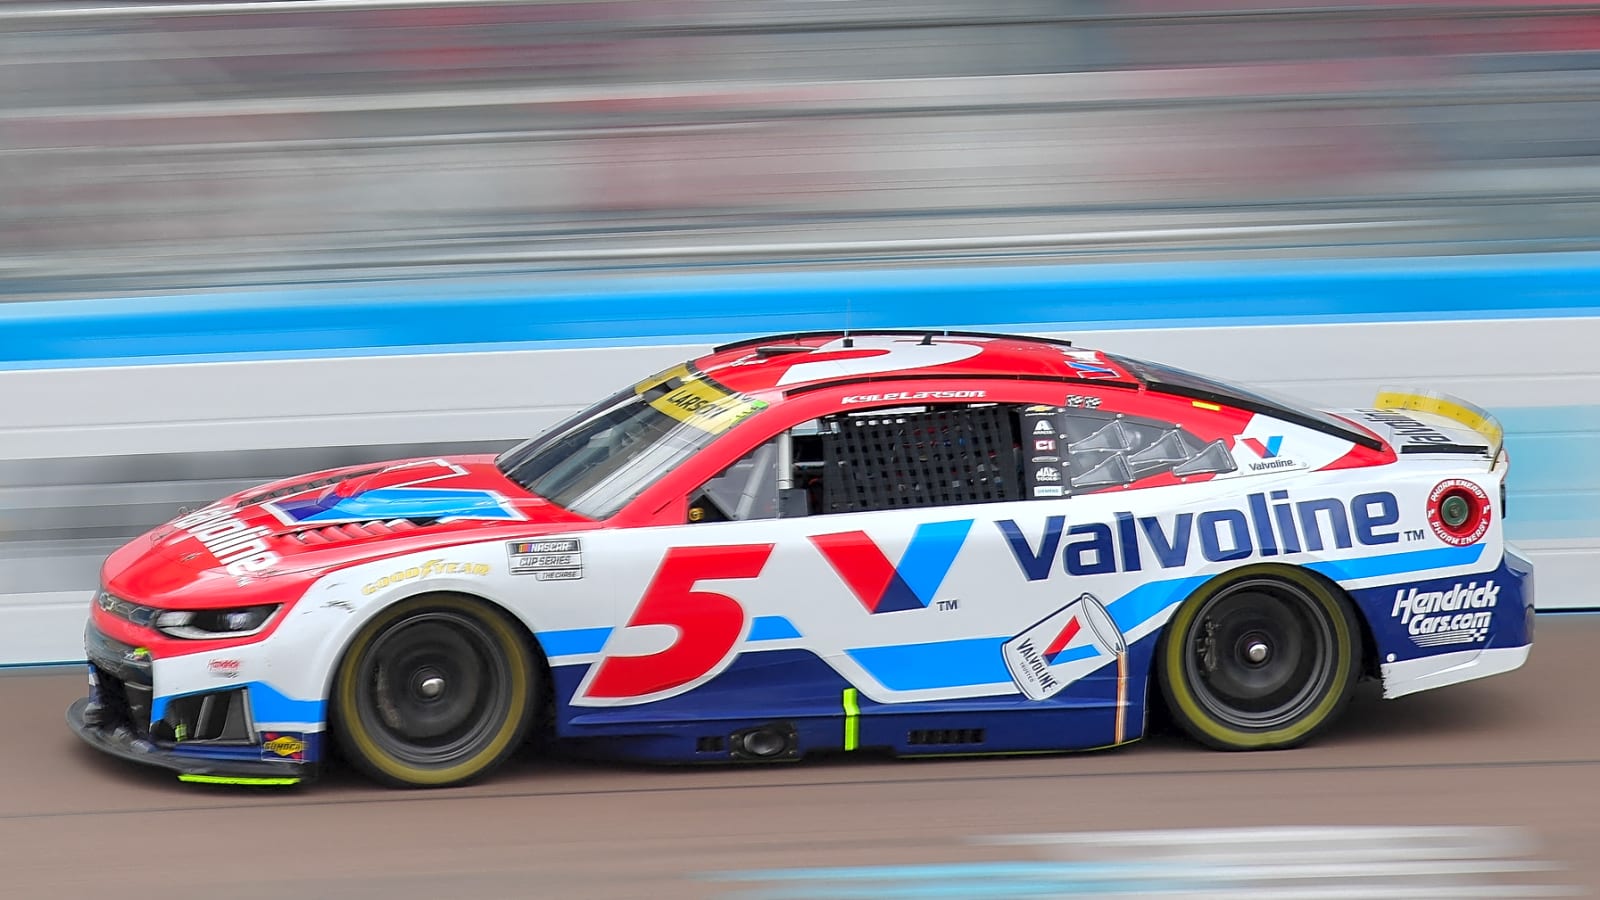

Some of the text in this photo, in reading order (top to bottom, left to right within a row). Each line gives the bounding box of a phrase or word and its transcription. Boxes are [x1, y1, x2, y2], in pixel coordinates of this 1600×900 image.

[667, 390, 729, 419] LARSON
[1248, 459, 1293, 471] Valvoline
[993, 490, 1425, 582] Valvoline TM
[1432, 518, 1489, 545] PHORM ENERGY
[520, 556, 571, 567] CUP SERIES
[530, 542, 569, 553] NASCAR
[361, 559, 490, 596] GOODYEAR
[936, 600, 959, 612] TM
[1391, 580, 1501, 624] Hendrick
[578, 542, 777, 699] 5
[1408, 612, 1492, 635] Cars.com
[1016, 638, 1058, 692] VALVOLINE
